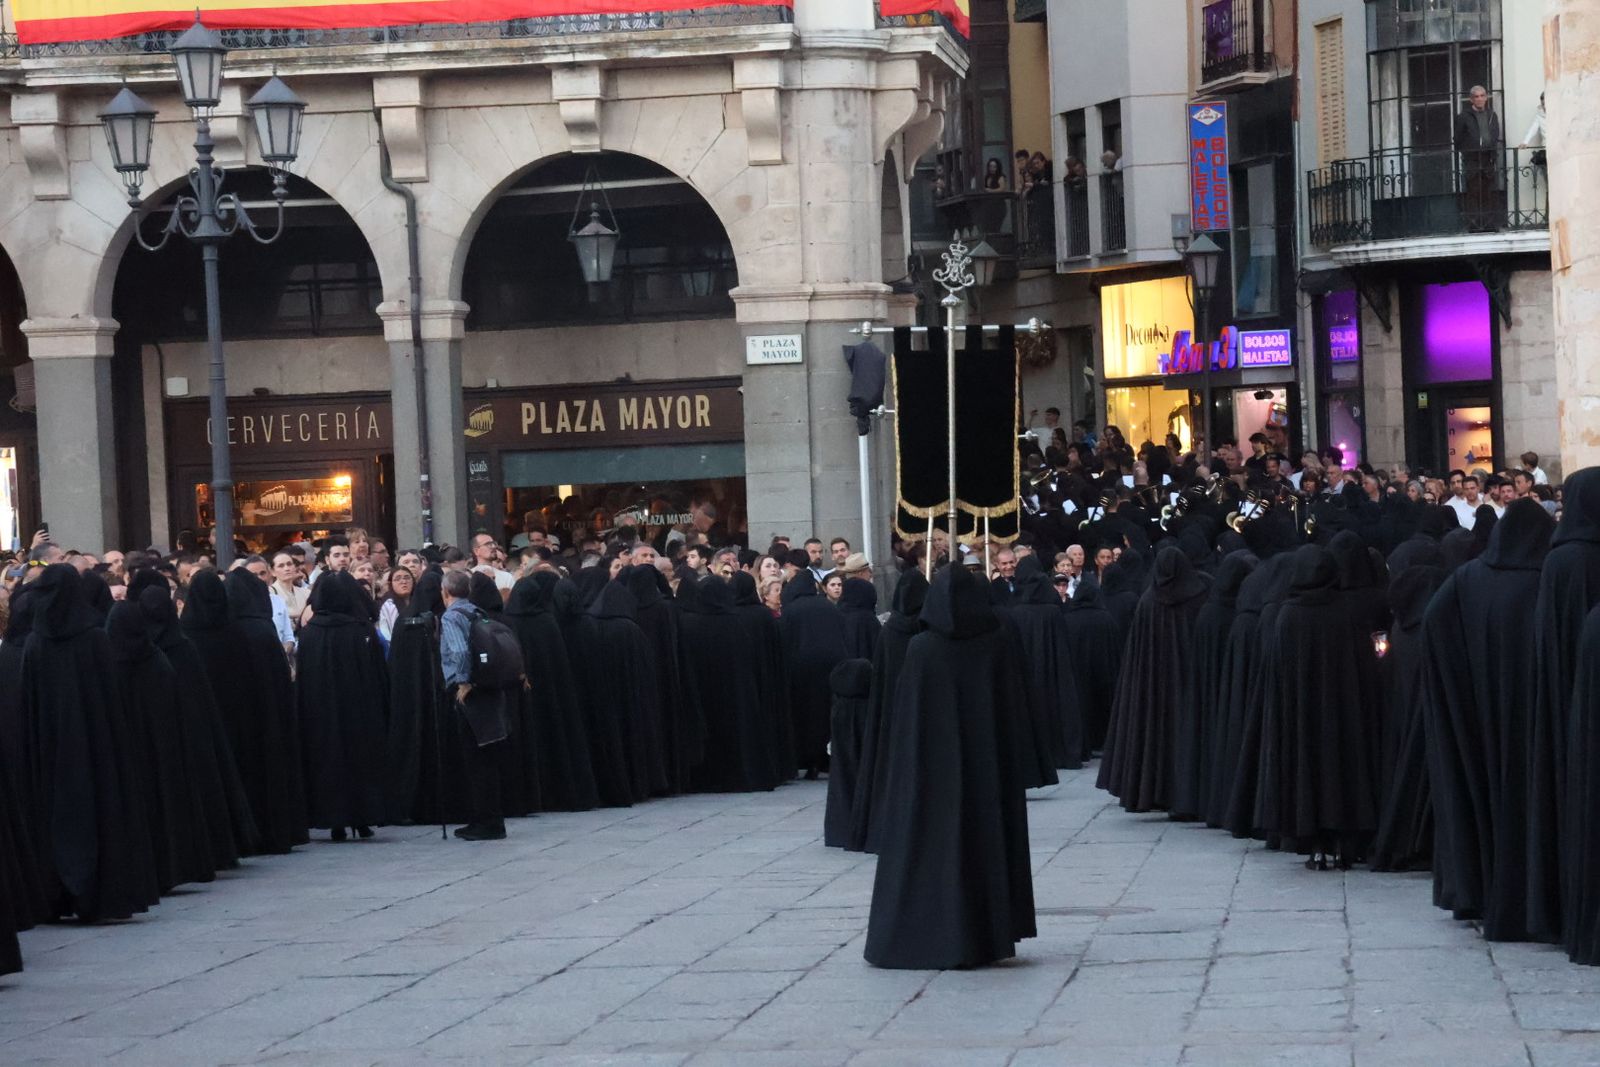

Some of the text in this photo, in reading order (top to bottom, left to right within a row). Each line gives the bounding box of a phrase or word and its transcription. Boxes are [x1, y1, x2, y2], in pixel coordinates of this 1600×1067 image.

[1192, 138, 1210, 229] MALETAS
[1210, 137, 1228, 229] BOLSOS
[763, 339, 796, 348] PLAZA
[1219, 325, 1238, 369] 3
[1244, 334, 1285, 349] BOLSOS
[761, 350, 798, 359] MAYOR
[1243, 349, 1289, 364] MALETAS
[521, 394, 711, 435] PLAZA MAYOR
[641, 513, 695, 526] PLAZA MAYOR
